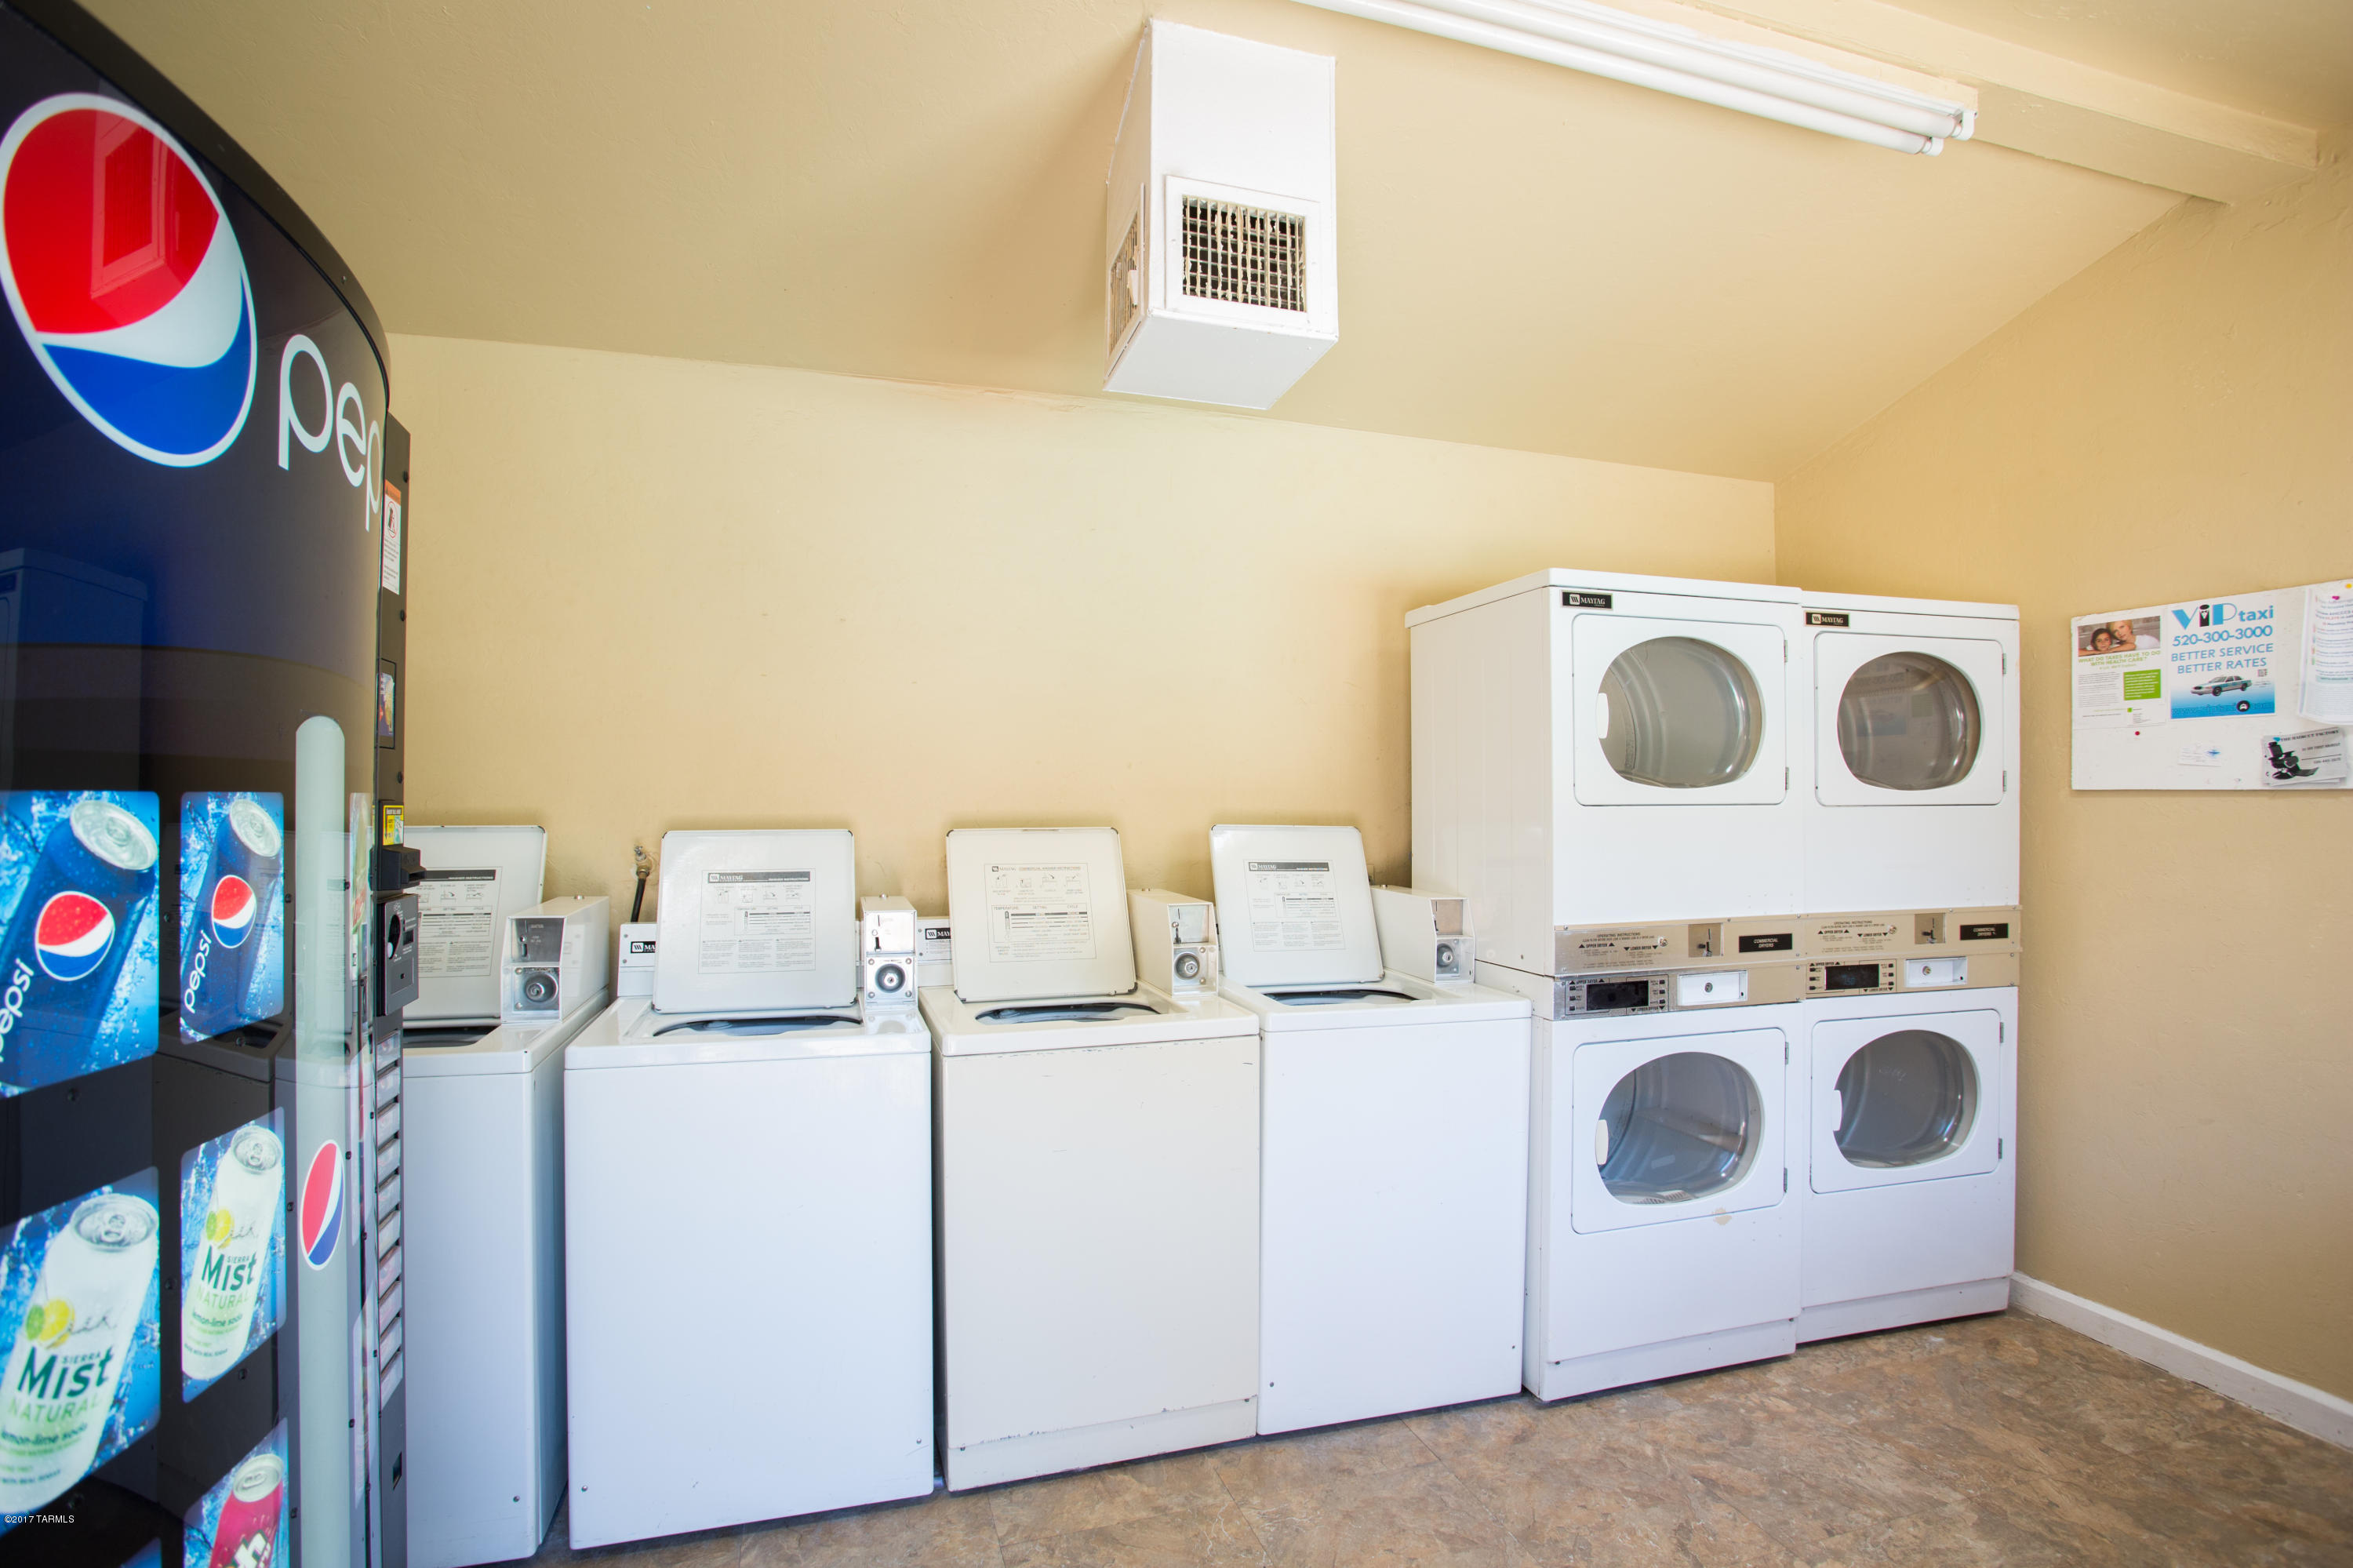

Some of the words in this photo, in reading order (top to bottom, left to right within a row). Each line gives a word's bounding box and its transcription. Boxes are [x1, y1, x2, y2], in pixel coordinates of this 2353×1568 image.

[2238, 605, 2274, 621] taxi
[2172, 625, 2273, 646] 520-300-3000
[2171, 649, 2216, 662] BETTER
[2219, 643, 2274, 657] SERVICE
[2177, 661, 2222, 674] BETTER
[2226, 657, 2268, 670] RATES
[184, 930, 212, 1014] pepsi
[0, 958, 35, 1063] epsi
[202, 1244, 257, 1291] Mist
[227, 1256, 249, 1264] SIERRA
[198, 1285, 249, 1310] NATURAL
[61, 1351, 101, 1364] SIERRA
[17, 1344, 114, 1399] Mist
[9, 1394, 100, 1424] NATURAL
